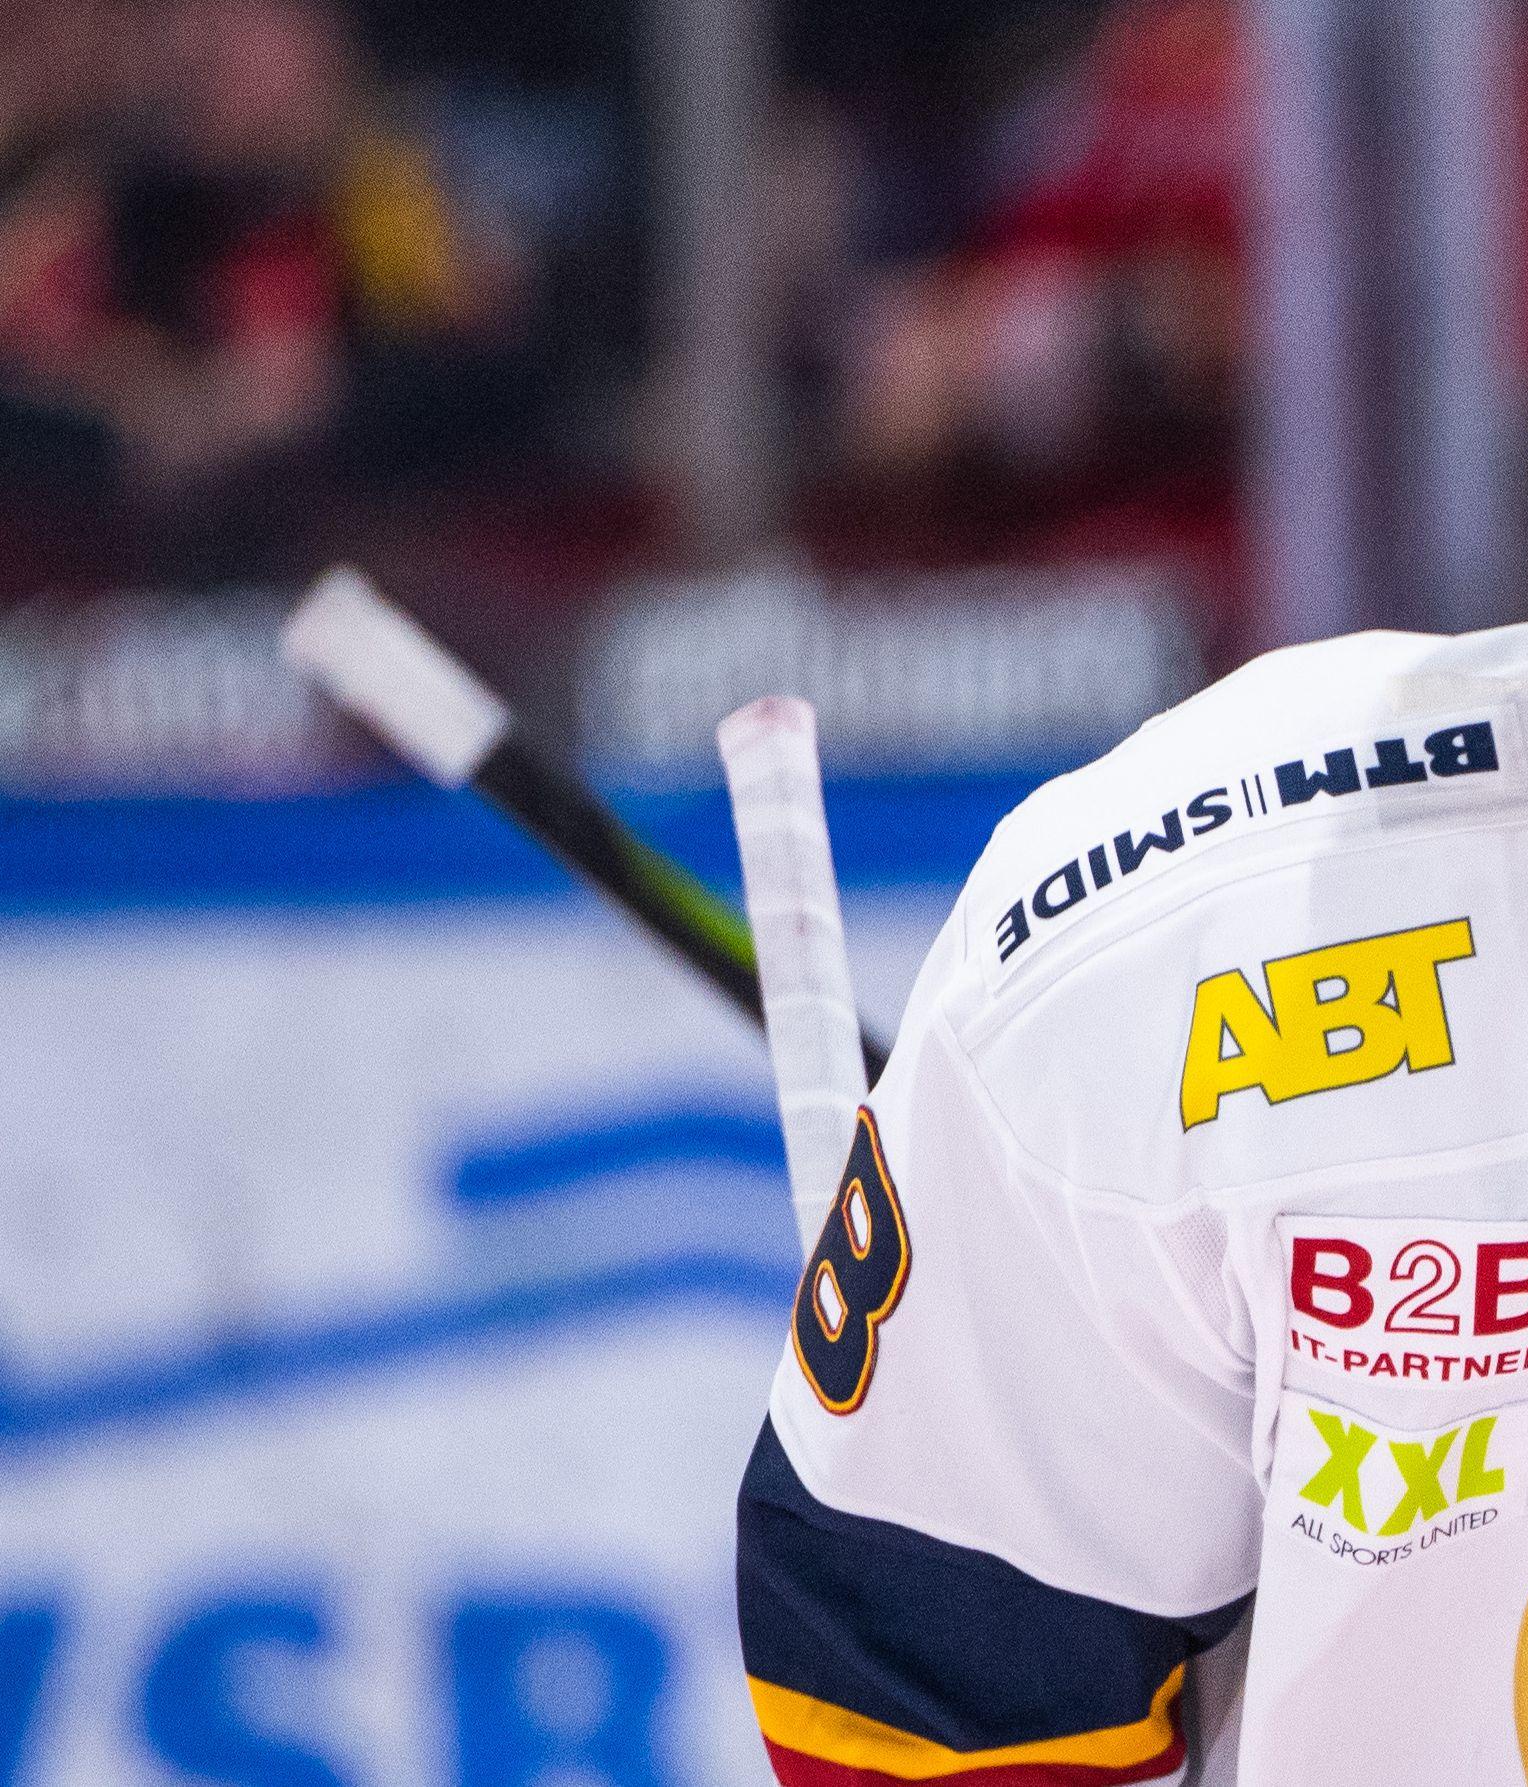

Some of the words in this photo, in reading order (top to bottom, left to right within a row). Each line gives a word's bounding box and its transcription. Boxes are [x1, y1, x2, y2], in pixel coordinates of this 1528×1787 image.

[1274, 721, 1499, 808] BTM
[995, 787, 1233, 964] SMIDE
[1180, 916, 1476, 1133] ABT
[792, 1105, 912, 1415] 8
[1291, 1514, 1325, 1543] ALL
[1330, 1532, 1413, 1566] SPORTS
[1420, 1508, 1498, 1550] UNITED
[1299, 1407, 1505, 1537] XXL
